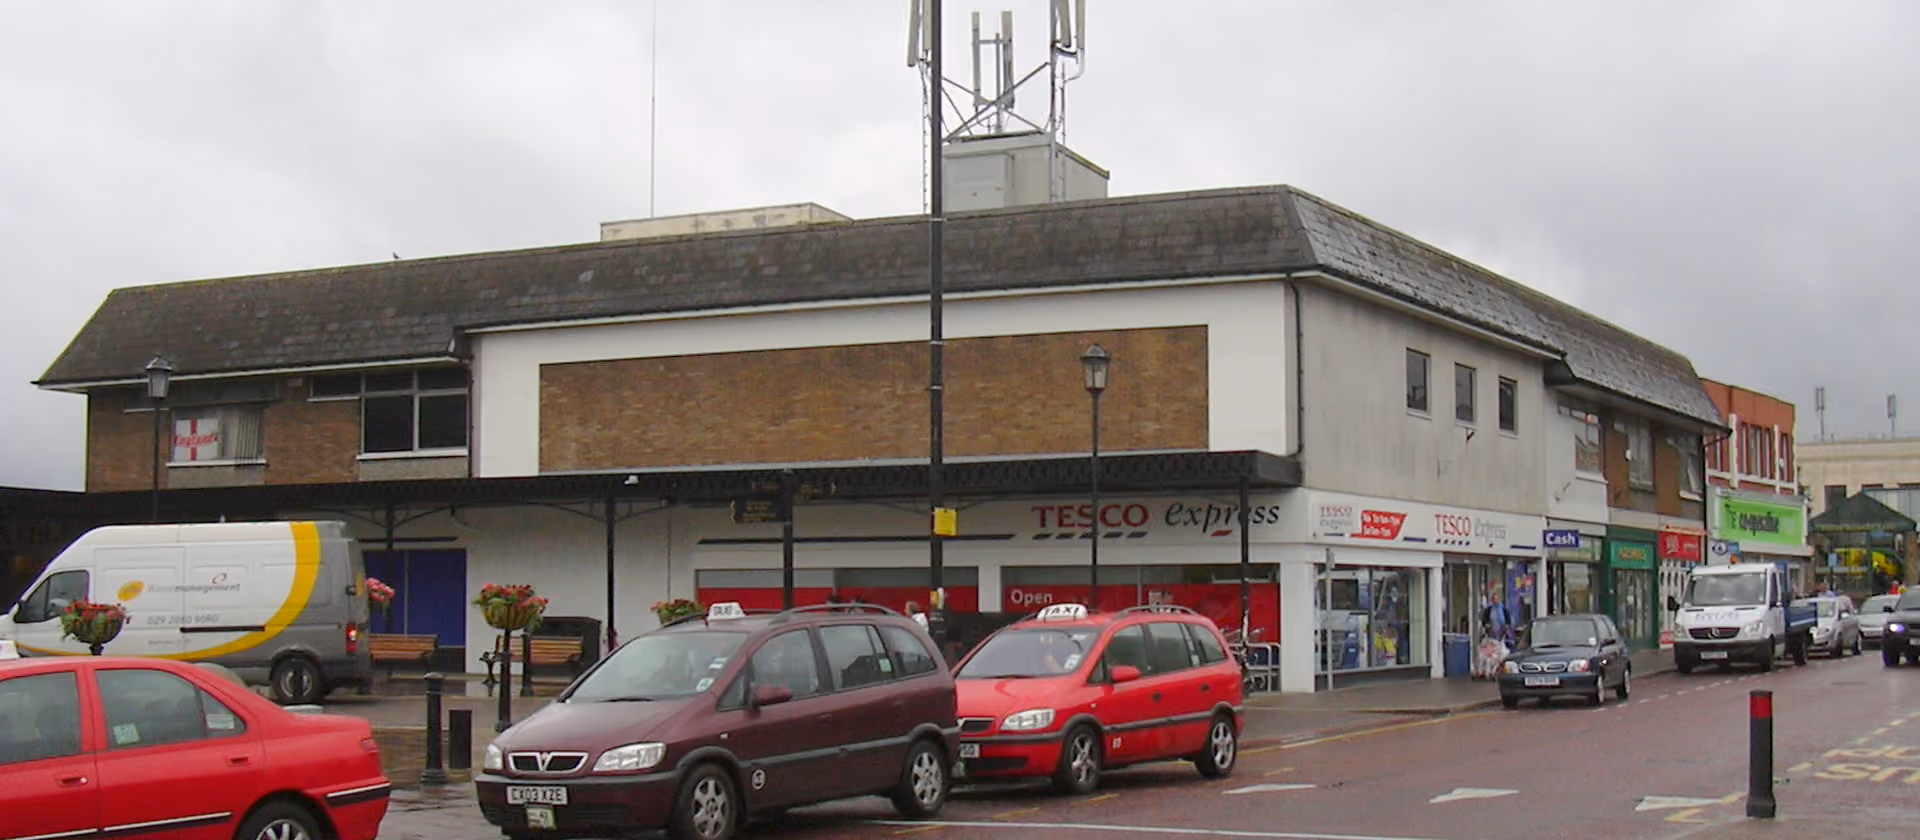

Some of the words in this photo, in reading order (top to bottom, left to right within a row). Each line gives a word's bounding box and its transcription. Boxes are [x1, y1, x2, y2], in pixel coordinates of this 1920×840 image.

[1032, 504, 1150, 528] TESCO
[1165, 503, 1280, 533] exprss
[1434, 514, 1472, 537] TESCO
[1545, 532, 1576, 546] Cash
[1010, 588, 1053, 606] Open
[1044, 606, 1080, 616] TAXI
